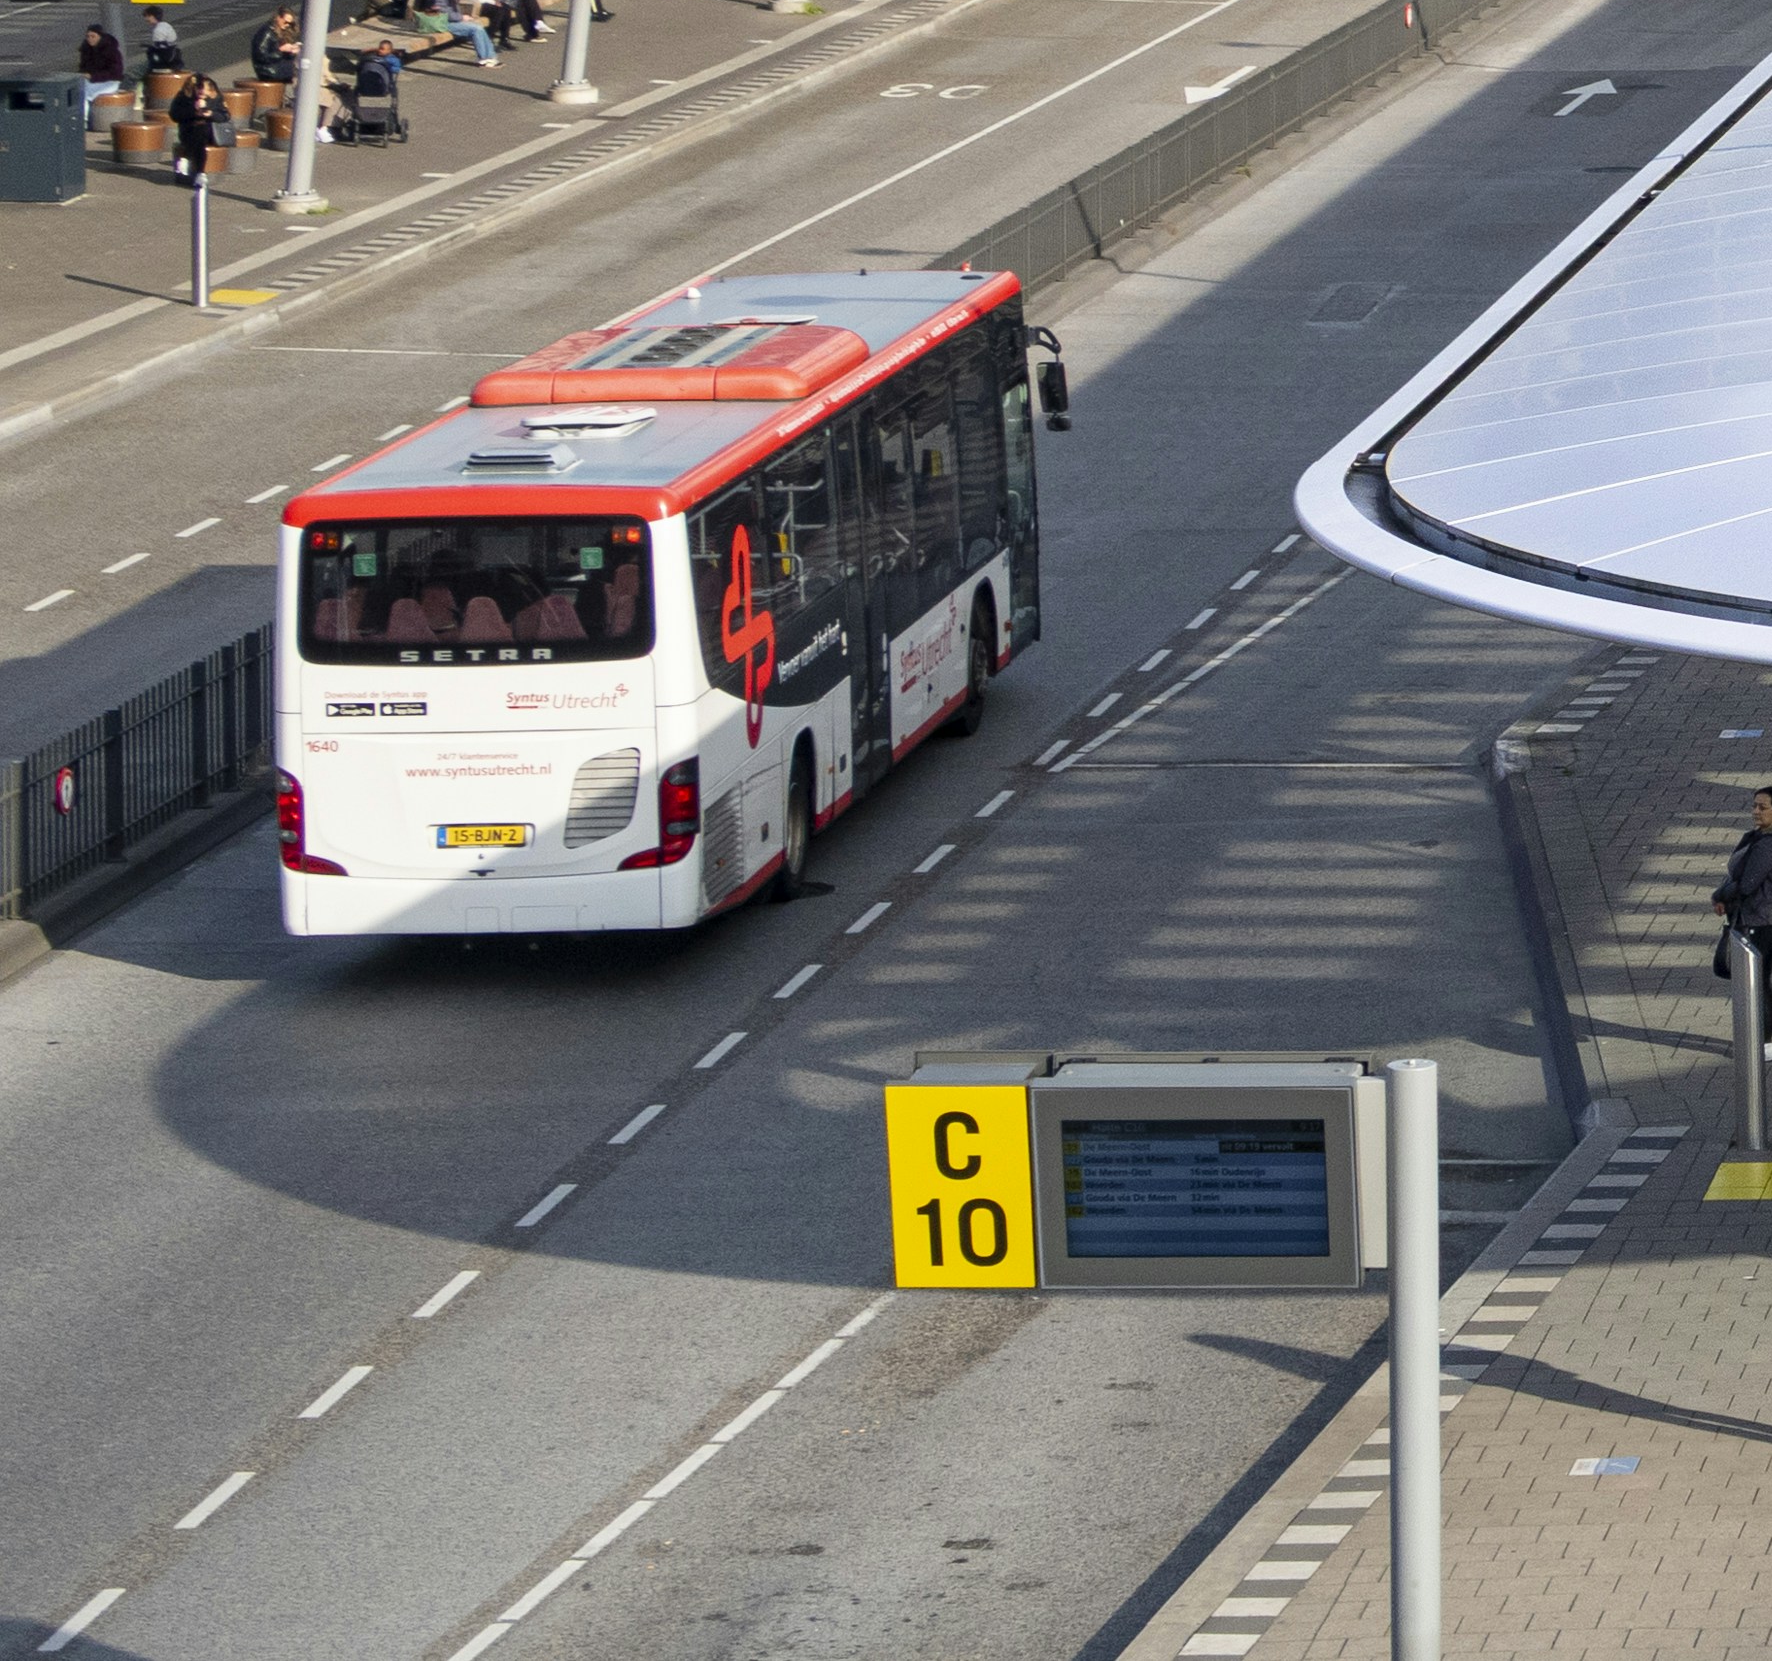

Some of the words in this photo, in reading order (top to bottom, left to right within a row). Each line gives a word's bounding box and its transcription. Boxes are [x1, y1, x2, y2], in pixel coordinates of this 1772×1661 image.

[400, 648, 552, 662] SETRA
[506, 692, 549, 705] Syntus
[552, 691, 618, 709] Utrecht
[307, 740, 339, 752] 1640
[405, 762, 552, 779] www.syntusutrecht.nl
[454, 828, 517, 843] 15-BJN-2
[933, 1111, 981, 1181] C
[916, 1198, 1009, 1268] 10
